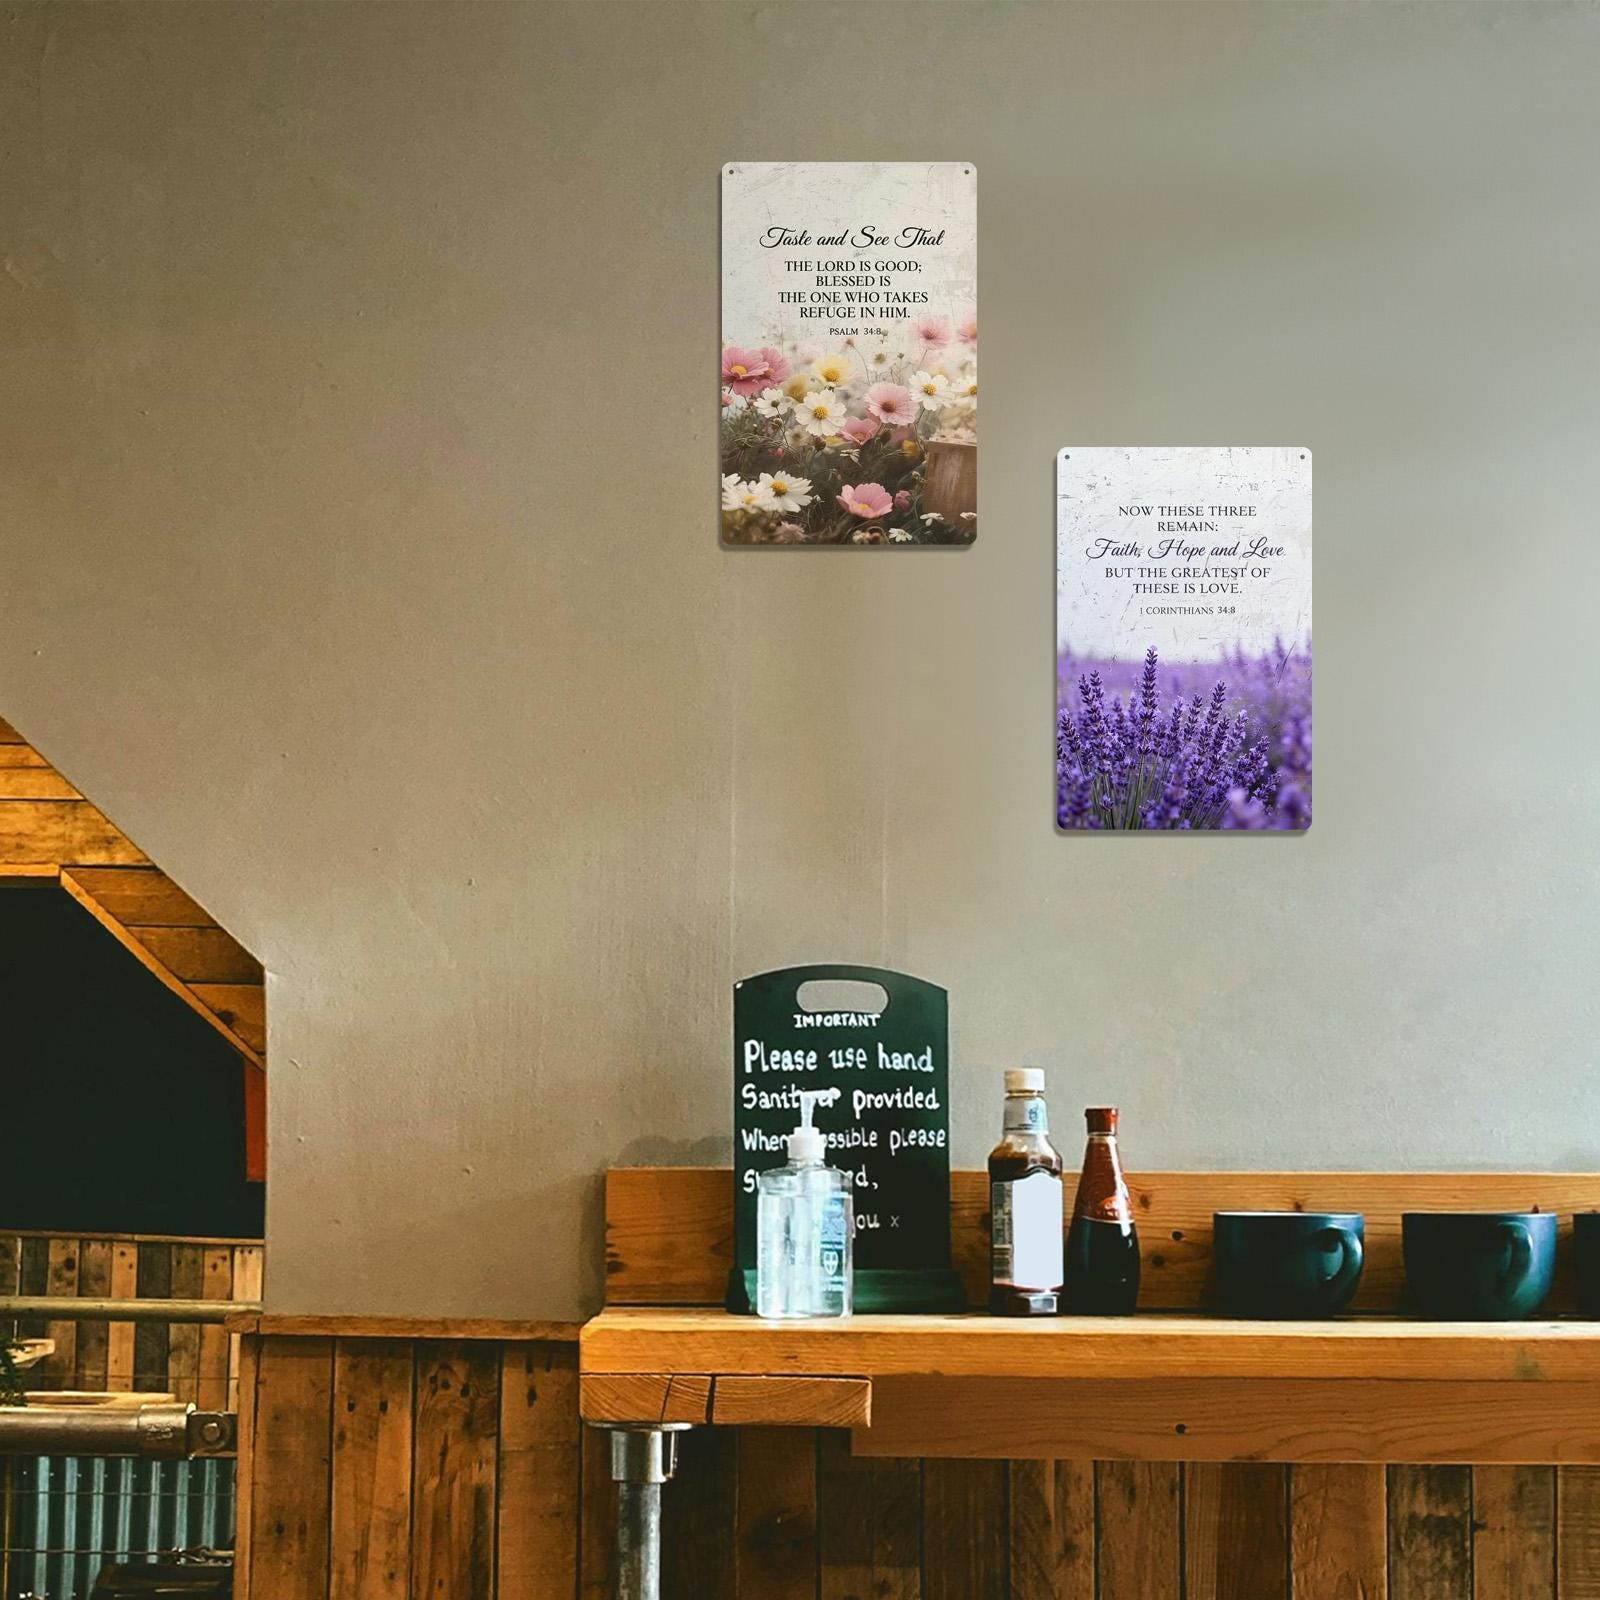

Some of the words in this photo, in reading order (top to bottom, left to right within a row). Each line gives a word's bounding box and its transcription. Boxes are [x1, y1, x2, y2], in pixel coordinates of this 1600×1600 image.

[759, 226, 812, 248] Taste
[817, 229, 849, 246] and
[850, 225, 890, 248] See
[894, 226, 946, 248] That
[784, 260, 813, 272] THE
[817, 260, 855, 272] LORD
[859, 260, 871, 272] IS
[874, 260, 922, 273] GOOD;
[815, 275, 875, 287] BLESSED
[879, 275, 891, 287] IS
[778, 291, 806, 303] THE
[810, 291, 841, 303] ONE
[844, 291, 880, 303] WHO
[883, 291, 929, 303] TAKES
[799, 306, 856, 318] REFUGE
[860, 306, 875, 318] IN
[879, 306, 911, 318] HIM.
[829, 327, 859, 336] PSALM
[863, 327, 882, 336] 34:8
[1118, 505, 1154, 517] NOW
[1157, 505, 1204, 517] THESE
[1208, 505, 1257, 517] THREE
[1157, 521, 1219, 532] REMAIN:
[1147, 538, 1206, 562] Hope
[1210, 541, 1240, 557] and
[1105, 567, 1134, 578] BUT
[1137, 567, 1167, 578] THE
[1171, 567, 1247, 578] GREATEST
[1251, 567, 1271, 578] OF
[1133, 583, 1180, 594] THESE
[1183, 583, 1196, 594] IS
[1199, 583, 1243, 594] LOVE.
[1145, 606, 1214, 615] CORINTHIANS
[1217, 606, 1236, 614] 34:8
[793, 1013, 881, 1028] IMPORTANT
[743, 1039, 818, 1074] Please
[828, 1048, 867, 1069] use
[878, 1042, 934, 1072] hand
[741, 1083, 834, 1109] Sanite
[852, 1086, 940, 1120] provided
[822, 1127, 877, 1149] ssible
[890, 1127, 946, 1156] please
